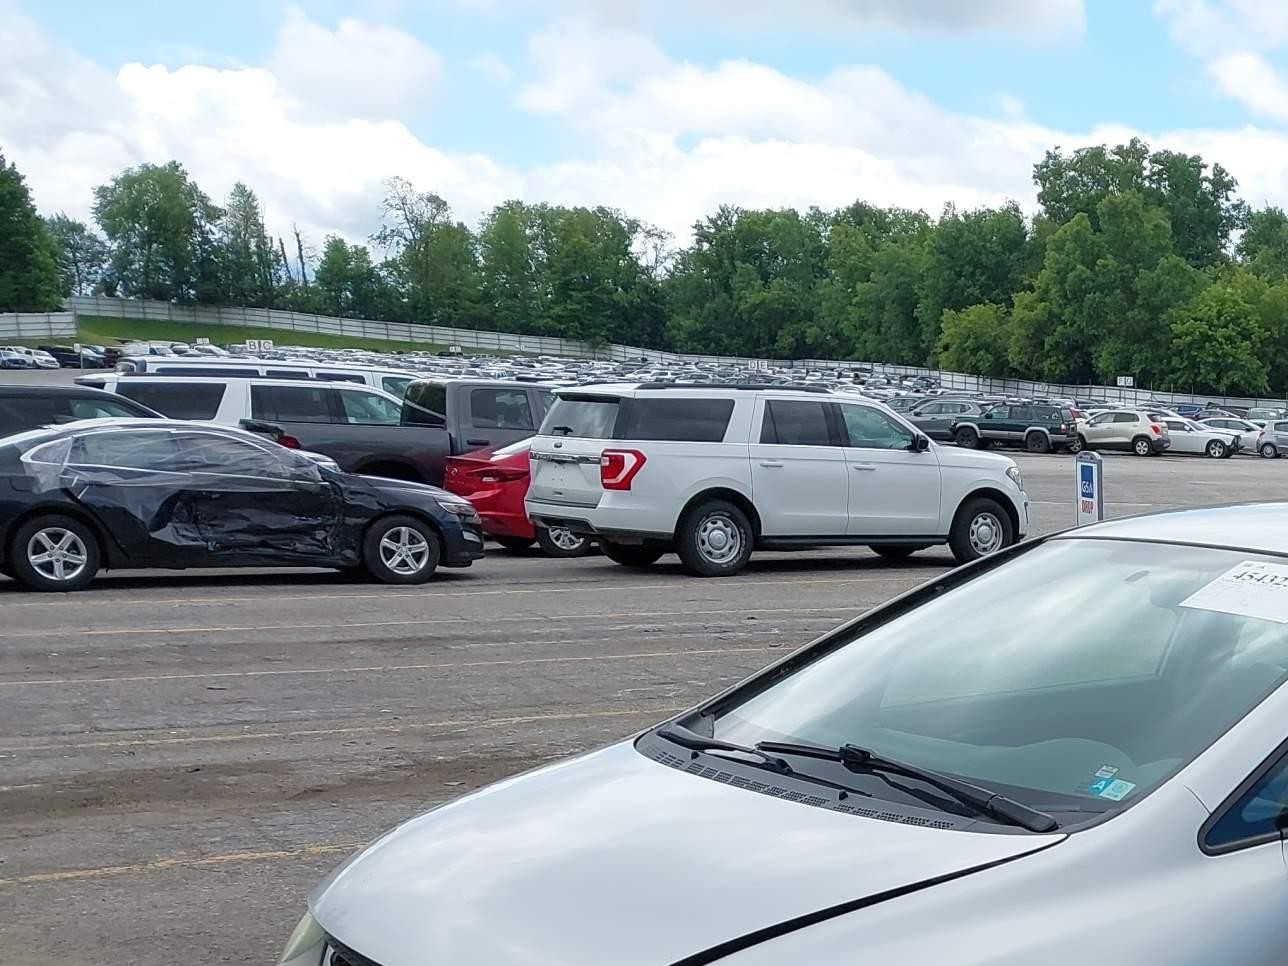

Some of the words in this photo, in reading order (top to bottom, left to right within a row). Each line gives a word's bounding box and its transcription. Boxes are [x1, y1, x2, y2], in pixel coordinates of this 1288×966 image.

[248, 341, 257, 350] B
[262, 341, 272, 350] C
[1082, 481, 1093, 494] GSA
